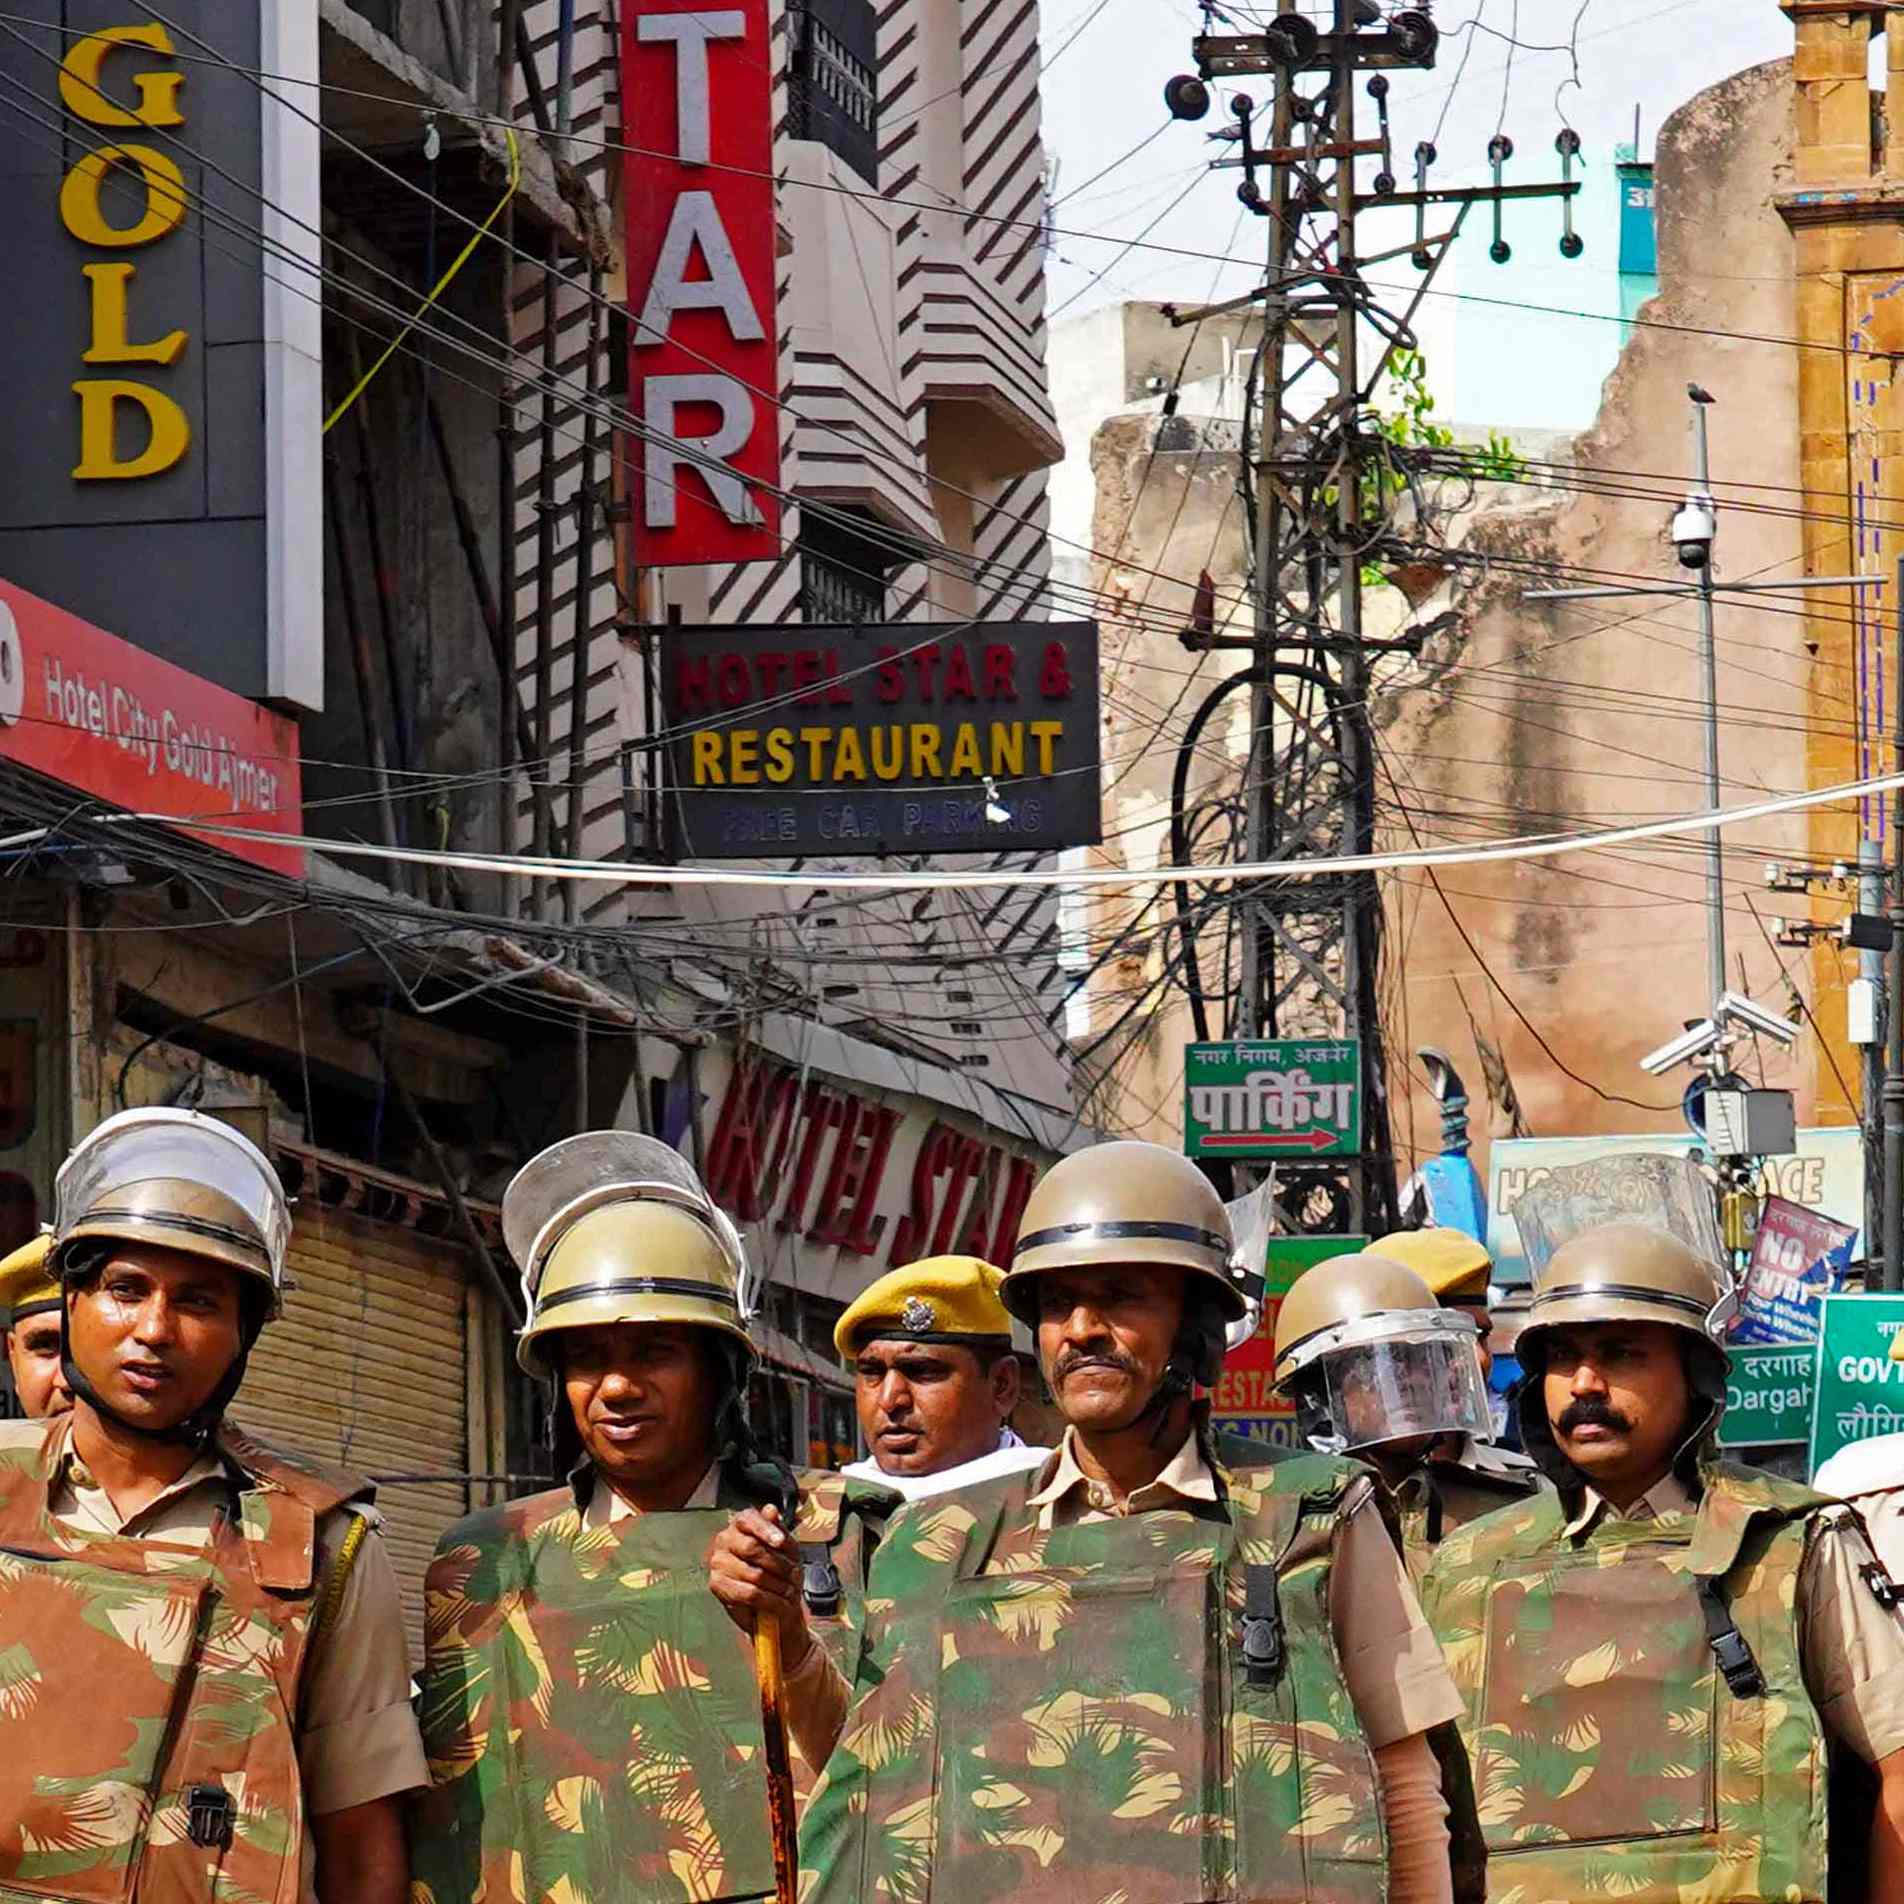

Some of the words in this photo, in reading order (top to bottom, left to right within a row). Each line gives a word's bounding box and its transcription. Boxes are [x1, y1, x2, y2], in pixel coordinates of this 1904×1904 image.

[58, 22, 192, 481] GOLD
[679, 645, 852, 712] HOTEL
[873, 641, 1019, 703] STAR
[1038, 640, 1075, 699] &
[43, 655, 109, 740] Hotel
[111, 686, 160, 776] City
[162, 710, 213, 785] Gold
[217, 736, 280, 814] Ajmer
[693, 720, 1064, 786] RESTAURANT
[1188, 1067, 1354, 1132] पार्किंग
[1758, 1231, 1806, 1272] NO
[1742, 1353, 1813, 1380] दरगाह
